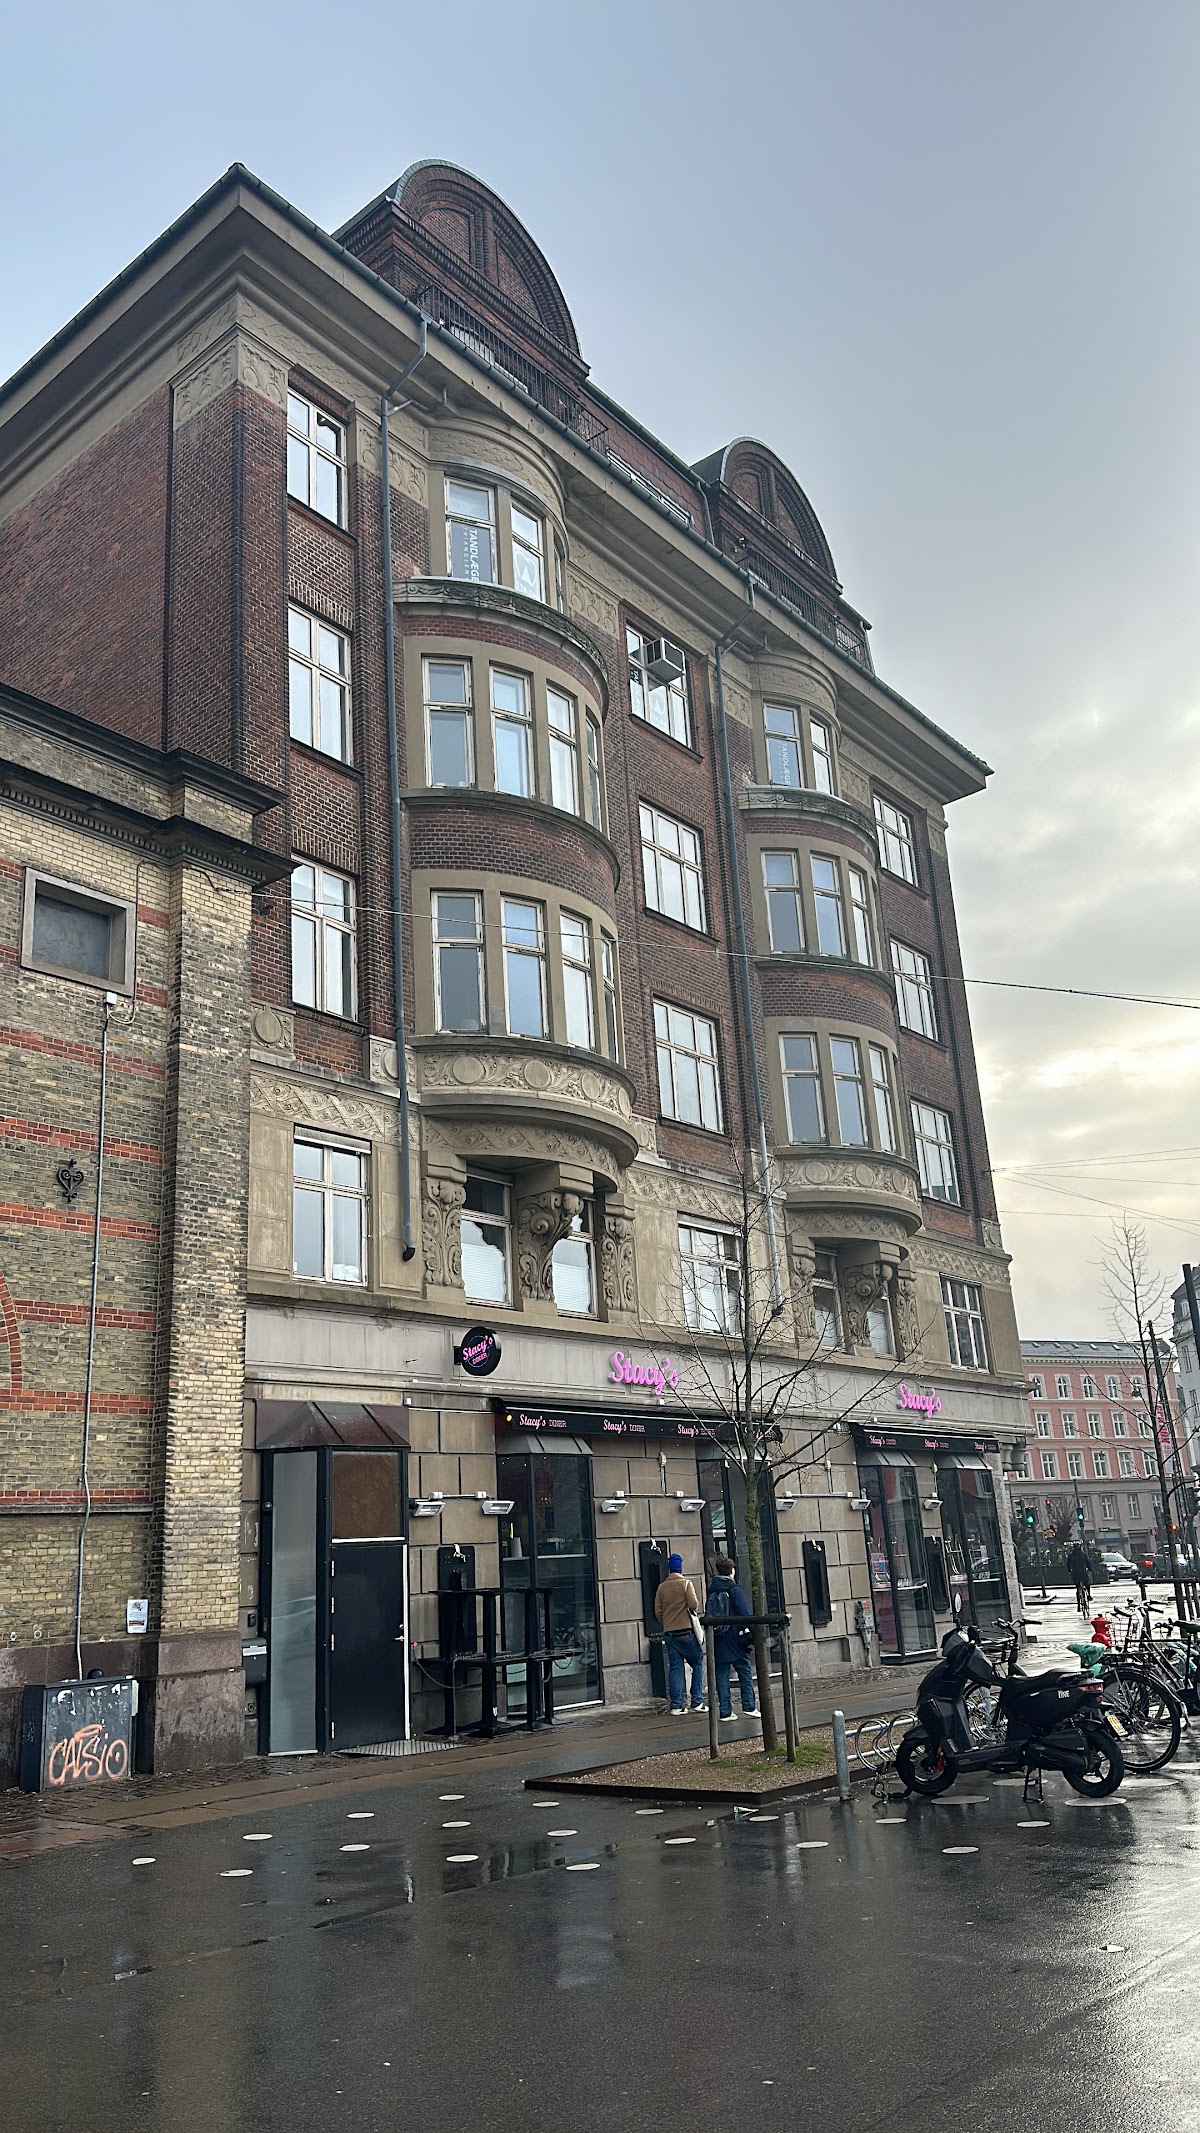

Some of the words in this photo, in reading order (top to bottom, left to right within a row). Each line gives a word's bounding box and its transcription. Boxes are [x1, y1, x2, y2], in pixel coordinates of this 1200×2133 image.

[462, 1335, 493, 1361] Stacy's
[611, 1351, 679, 1395] Stacy's
[900, 1383, 942, 1418] Stacy's
[519, 1413, 546, 1430] Stacy's
[603, 1419, 627, 1434] Stacy's
[677, 1424, 699, 1437] Stacy's
